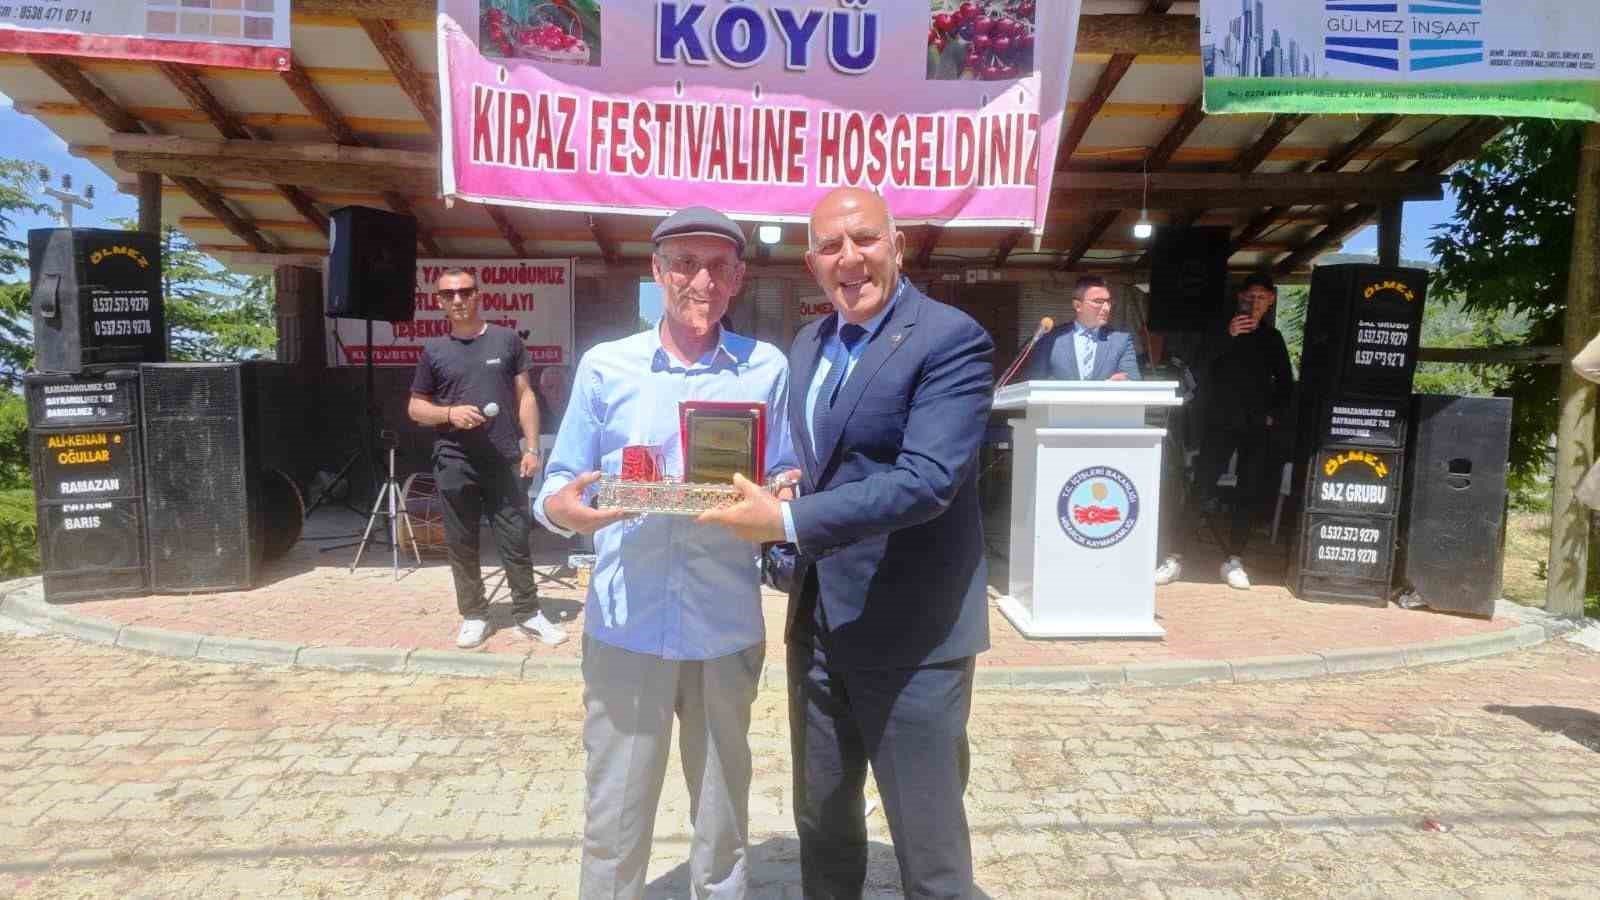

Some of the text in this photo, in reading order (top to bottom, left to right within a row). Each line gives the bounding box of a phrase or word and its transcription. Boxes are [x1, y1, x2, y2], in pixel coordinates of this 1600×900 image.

[1327, 15, 1481, 38] GÜLMEZ İNŞAAT
[472, 67, 578, 170] KİRAZ
[590, 80, 808, 184] FESTİVALİNE
[481, 262, 564, 285] OLDUĞUNUZ
[482, 293, 535, 311] DOLAYI
[60, 479, 120, 495] RAMAZAN
[1321, 482, 1388, 504] SAZ GRUBU
[1359, 527, 1380, 543] 9279
[1357, 548, 1378, 564] 9278
